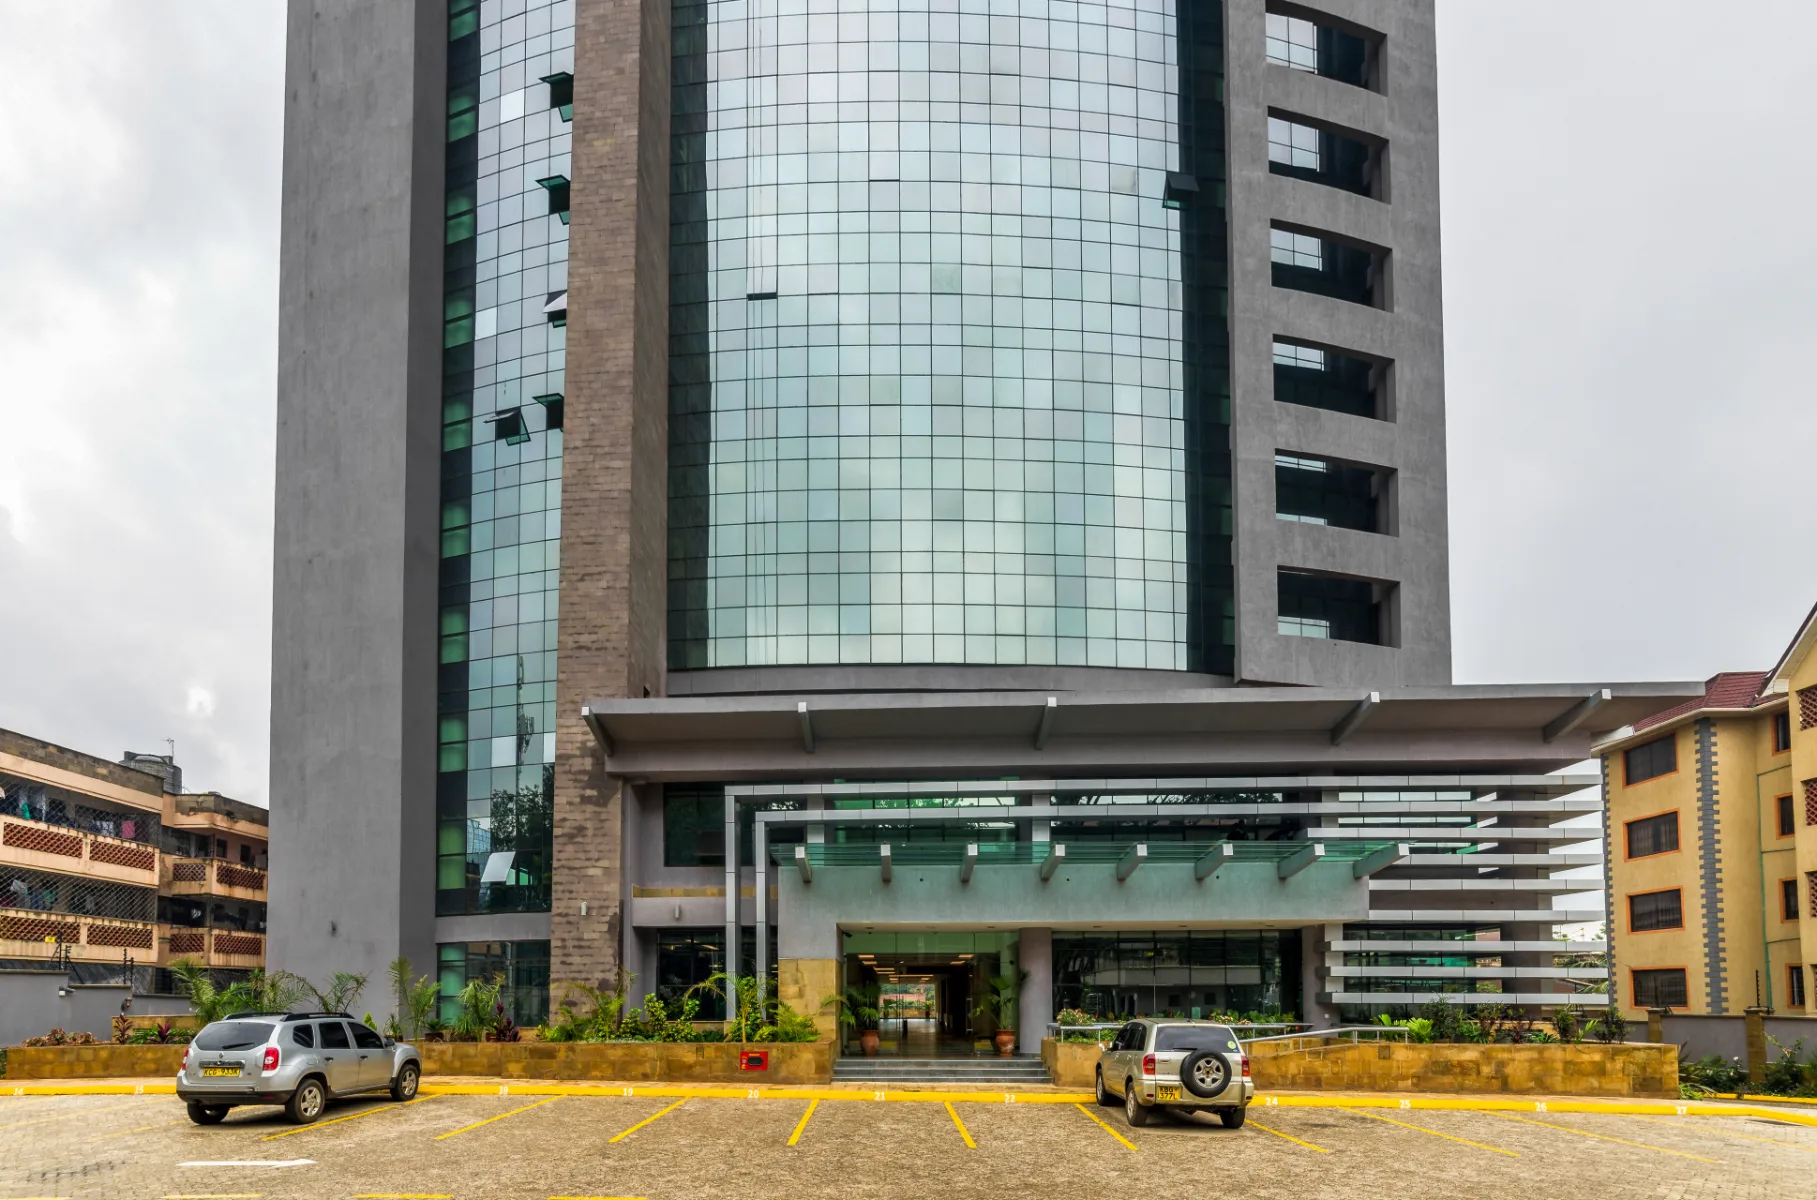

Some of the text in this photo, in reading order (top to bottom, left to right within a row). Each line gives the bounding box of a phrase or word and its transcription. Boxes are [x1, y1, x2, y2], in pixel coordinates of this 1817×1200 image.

[203, 1068, 217, 1076] KCG
[499, 1086, 508, 1095] 18
[623, 1087, 633, 1097] 19
[748, 1089, 759, 1099] 20
[875, 1091, 886, 1101] 21
[1004, 1093, 1016, 1103] 22
[1265, 1097, 1278, 1106] 24
[1400, 1099, 1411, 1109] 25
[1535, 1102, 1547, 1112] 26
